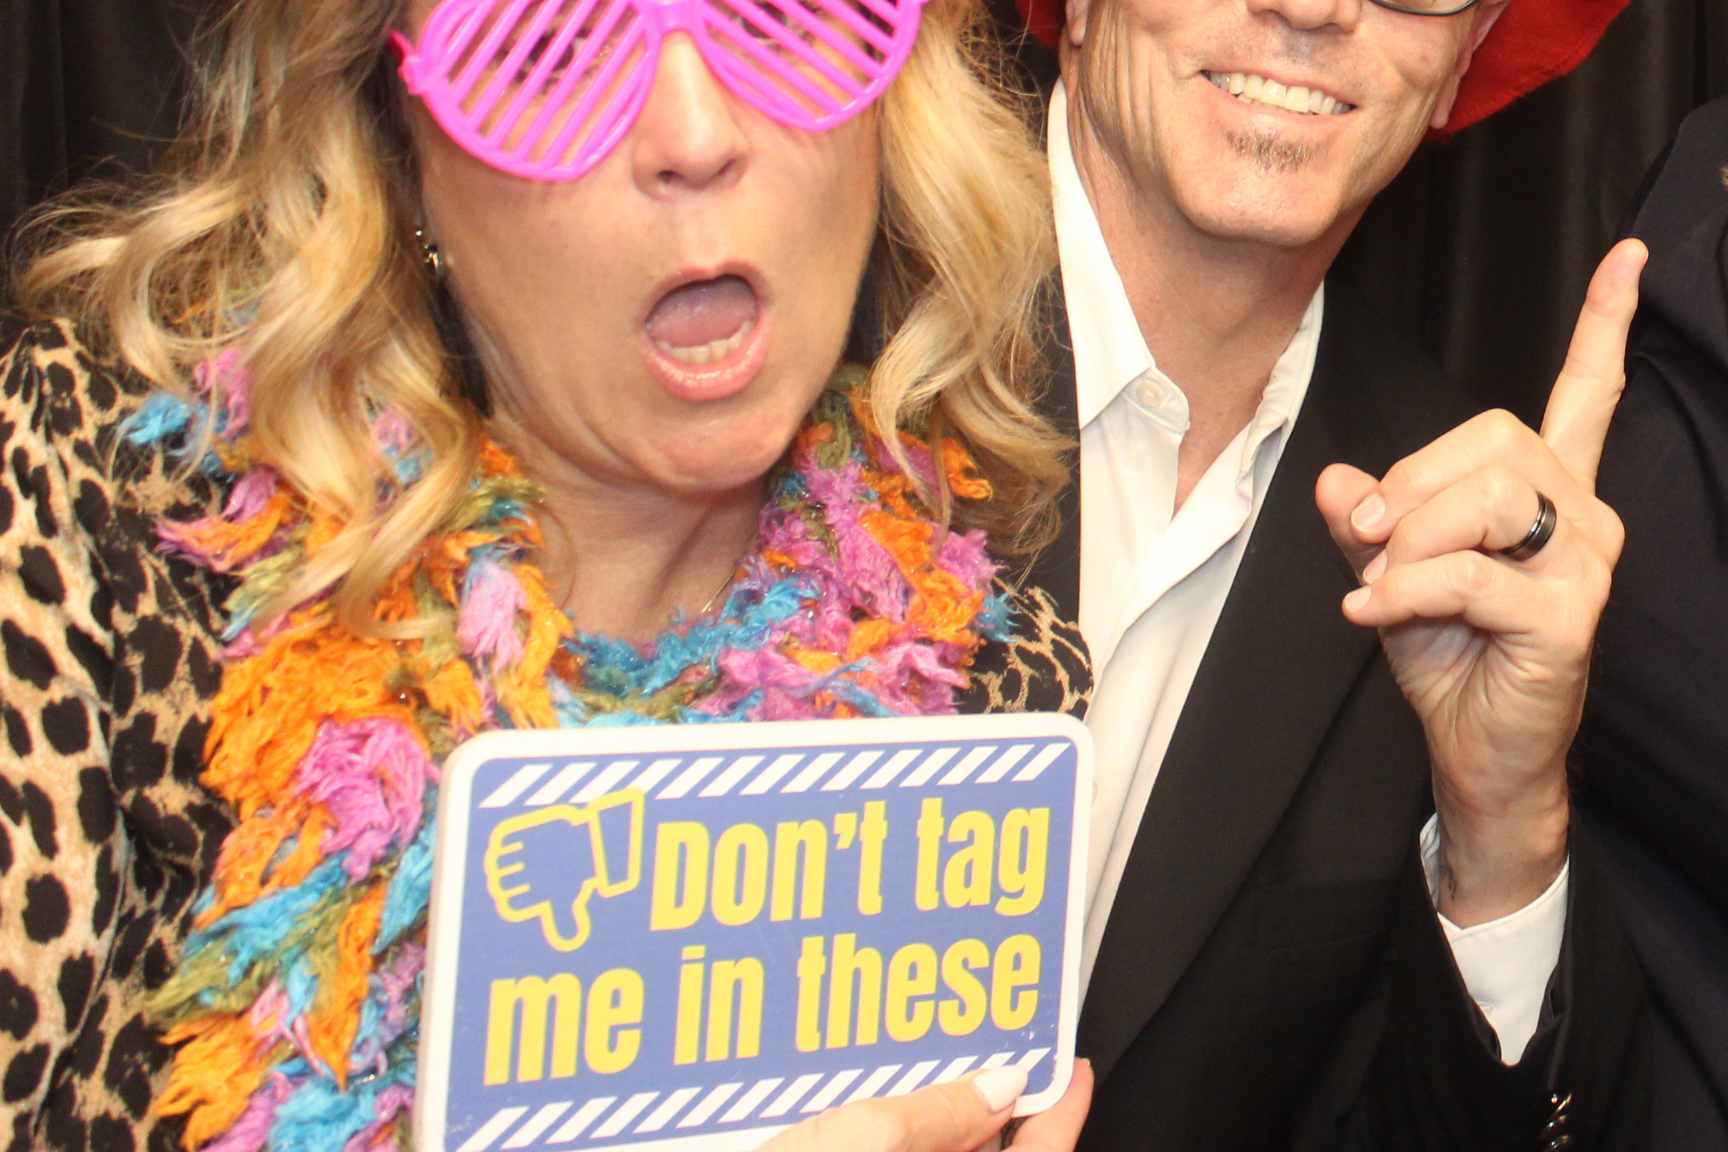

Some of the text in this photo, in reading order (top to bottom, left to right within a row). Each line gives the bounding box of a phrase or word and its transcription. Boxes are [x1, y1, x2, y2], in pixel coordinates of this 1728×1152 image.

[649, 796, 1051, 932] Don't tag
[482, 932, 1042, 1086] me in these
